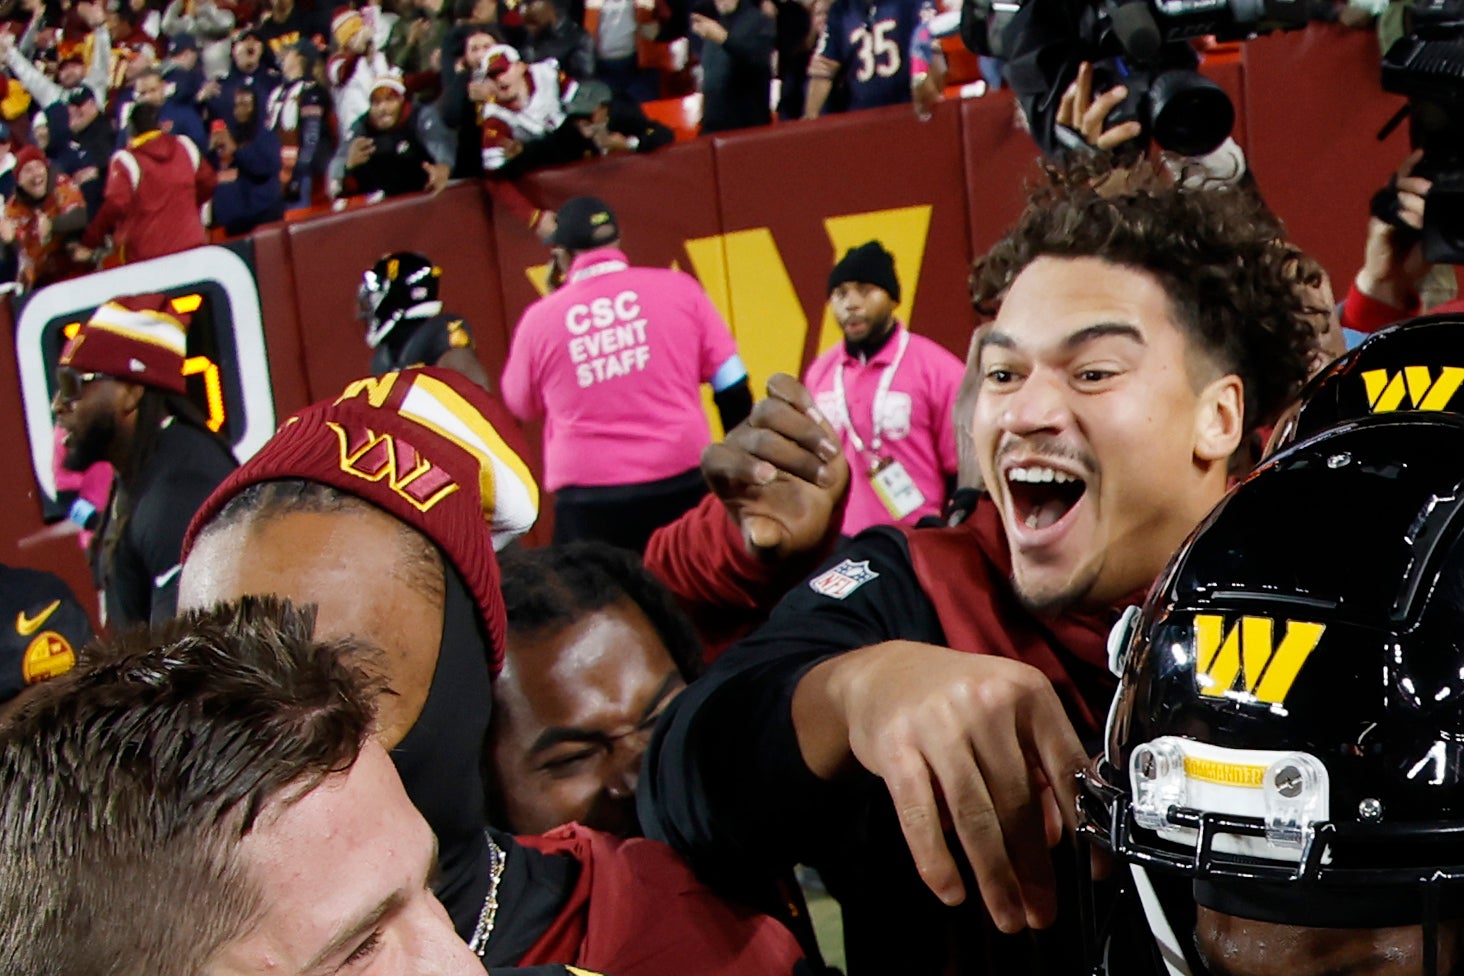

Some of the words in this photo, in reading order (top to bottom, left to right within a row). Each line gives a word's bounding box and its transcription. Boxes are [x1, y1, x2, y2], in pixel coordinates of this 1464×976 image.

[849, 19, 901, 82] 35
[565, 289, 641, 335] CSC
[568, 318, 648, 365] EVENT
[576, 345, 651, 389] STAFF
